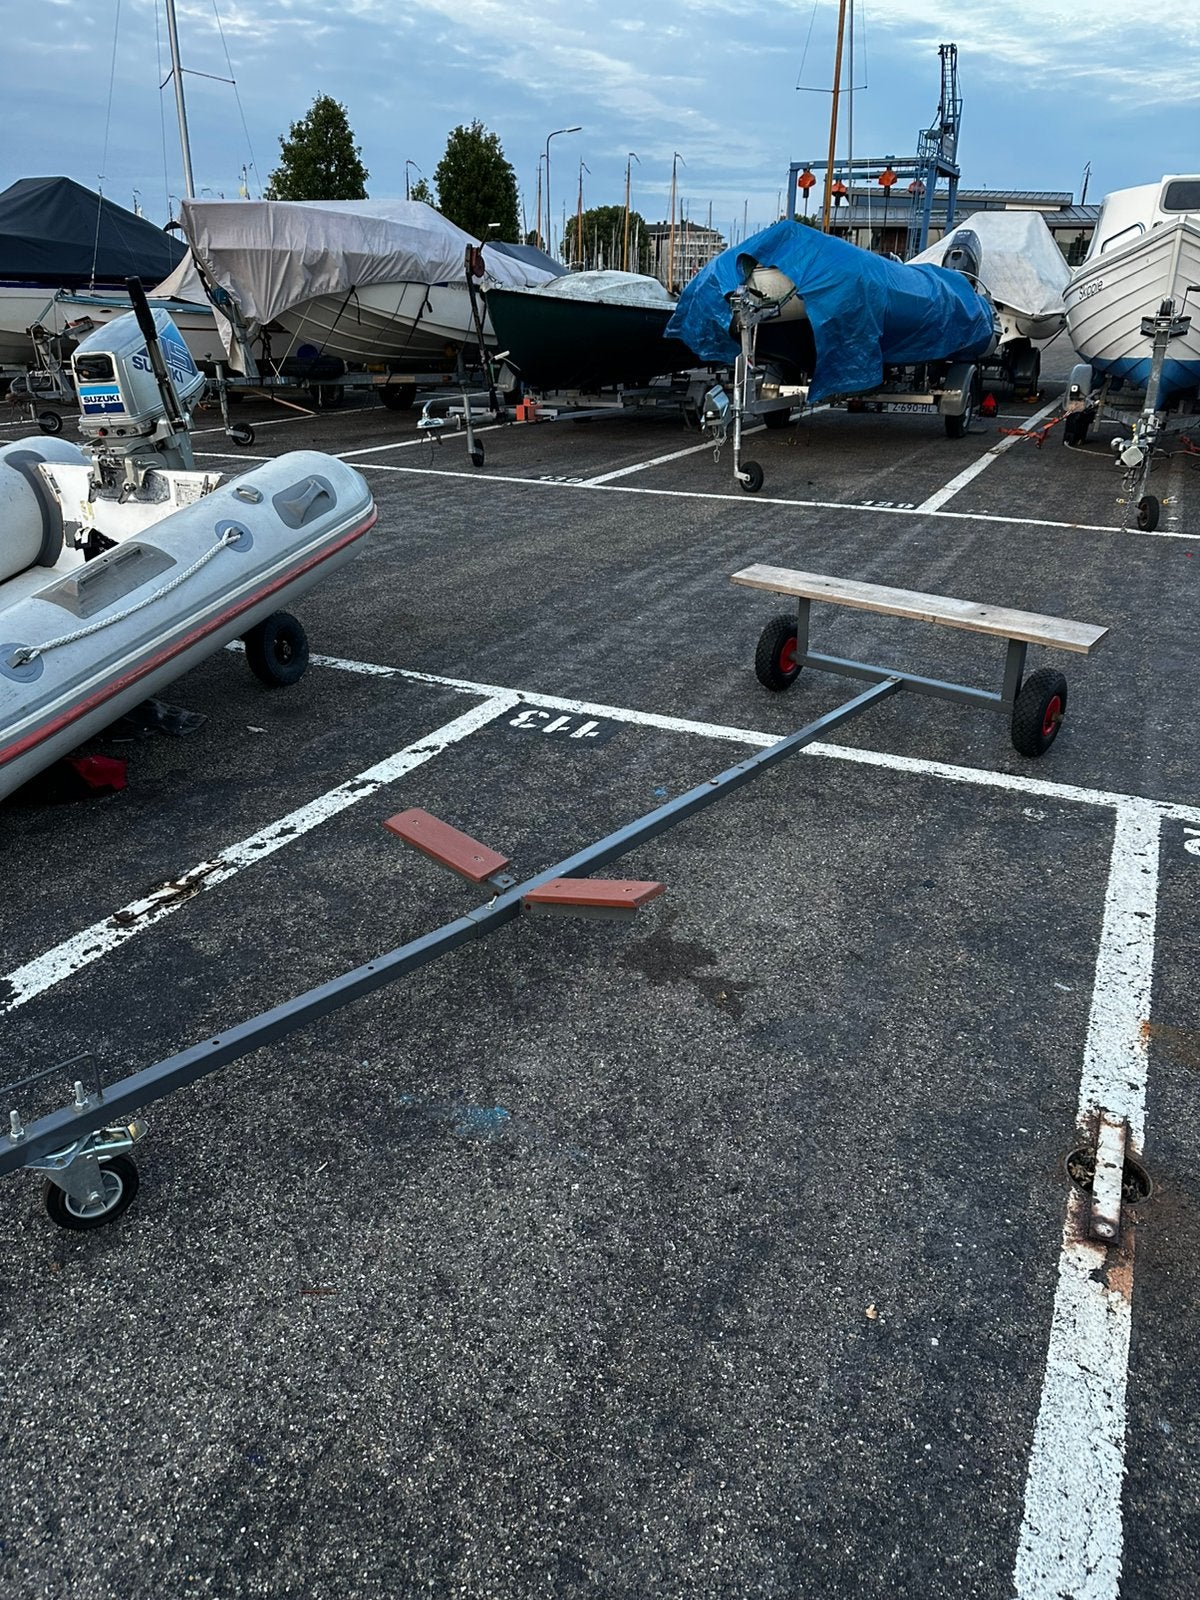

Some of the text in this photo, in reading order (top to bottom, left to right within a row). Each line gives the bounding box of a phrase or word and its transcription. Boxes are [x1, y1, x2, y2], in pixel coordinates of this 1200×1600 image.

[132, 356, 184, 383] SUKI
[83, 395, 120, 403] SUZUKI
[509, 710, 600, 738] 113
